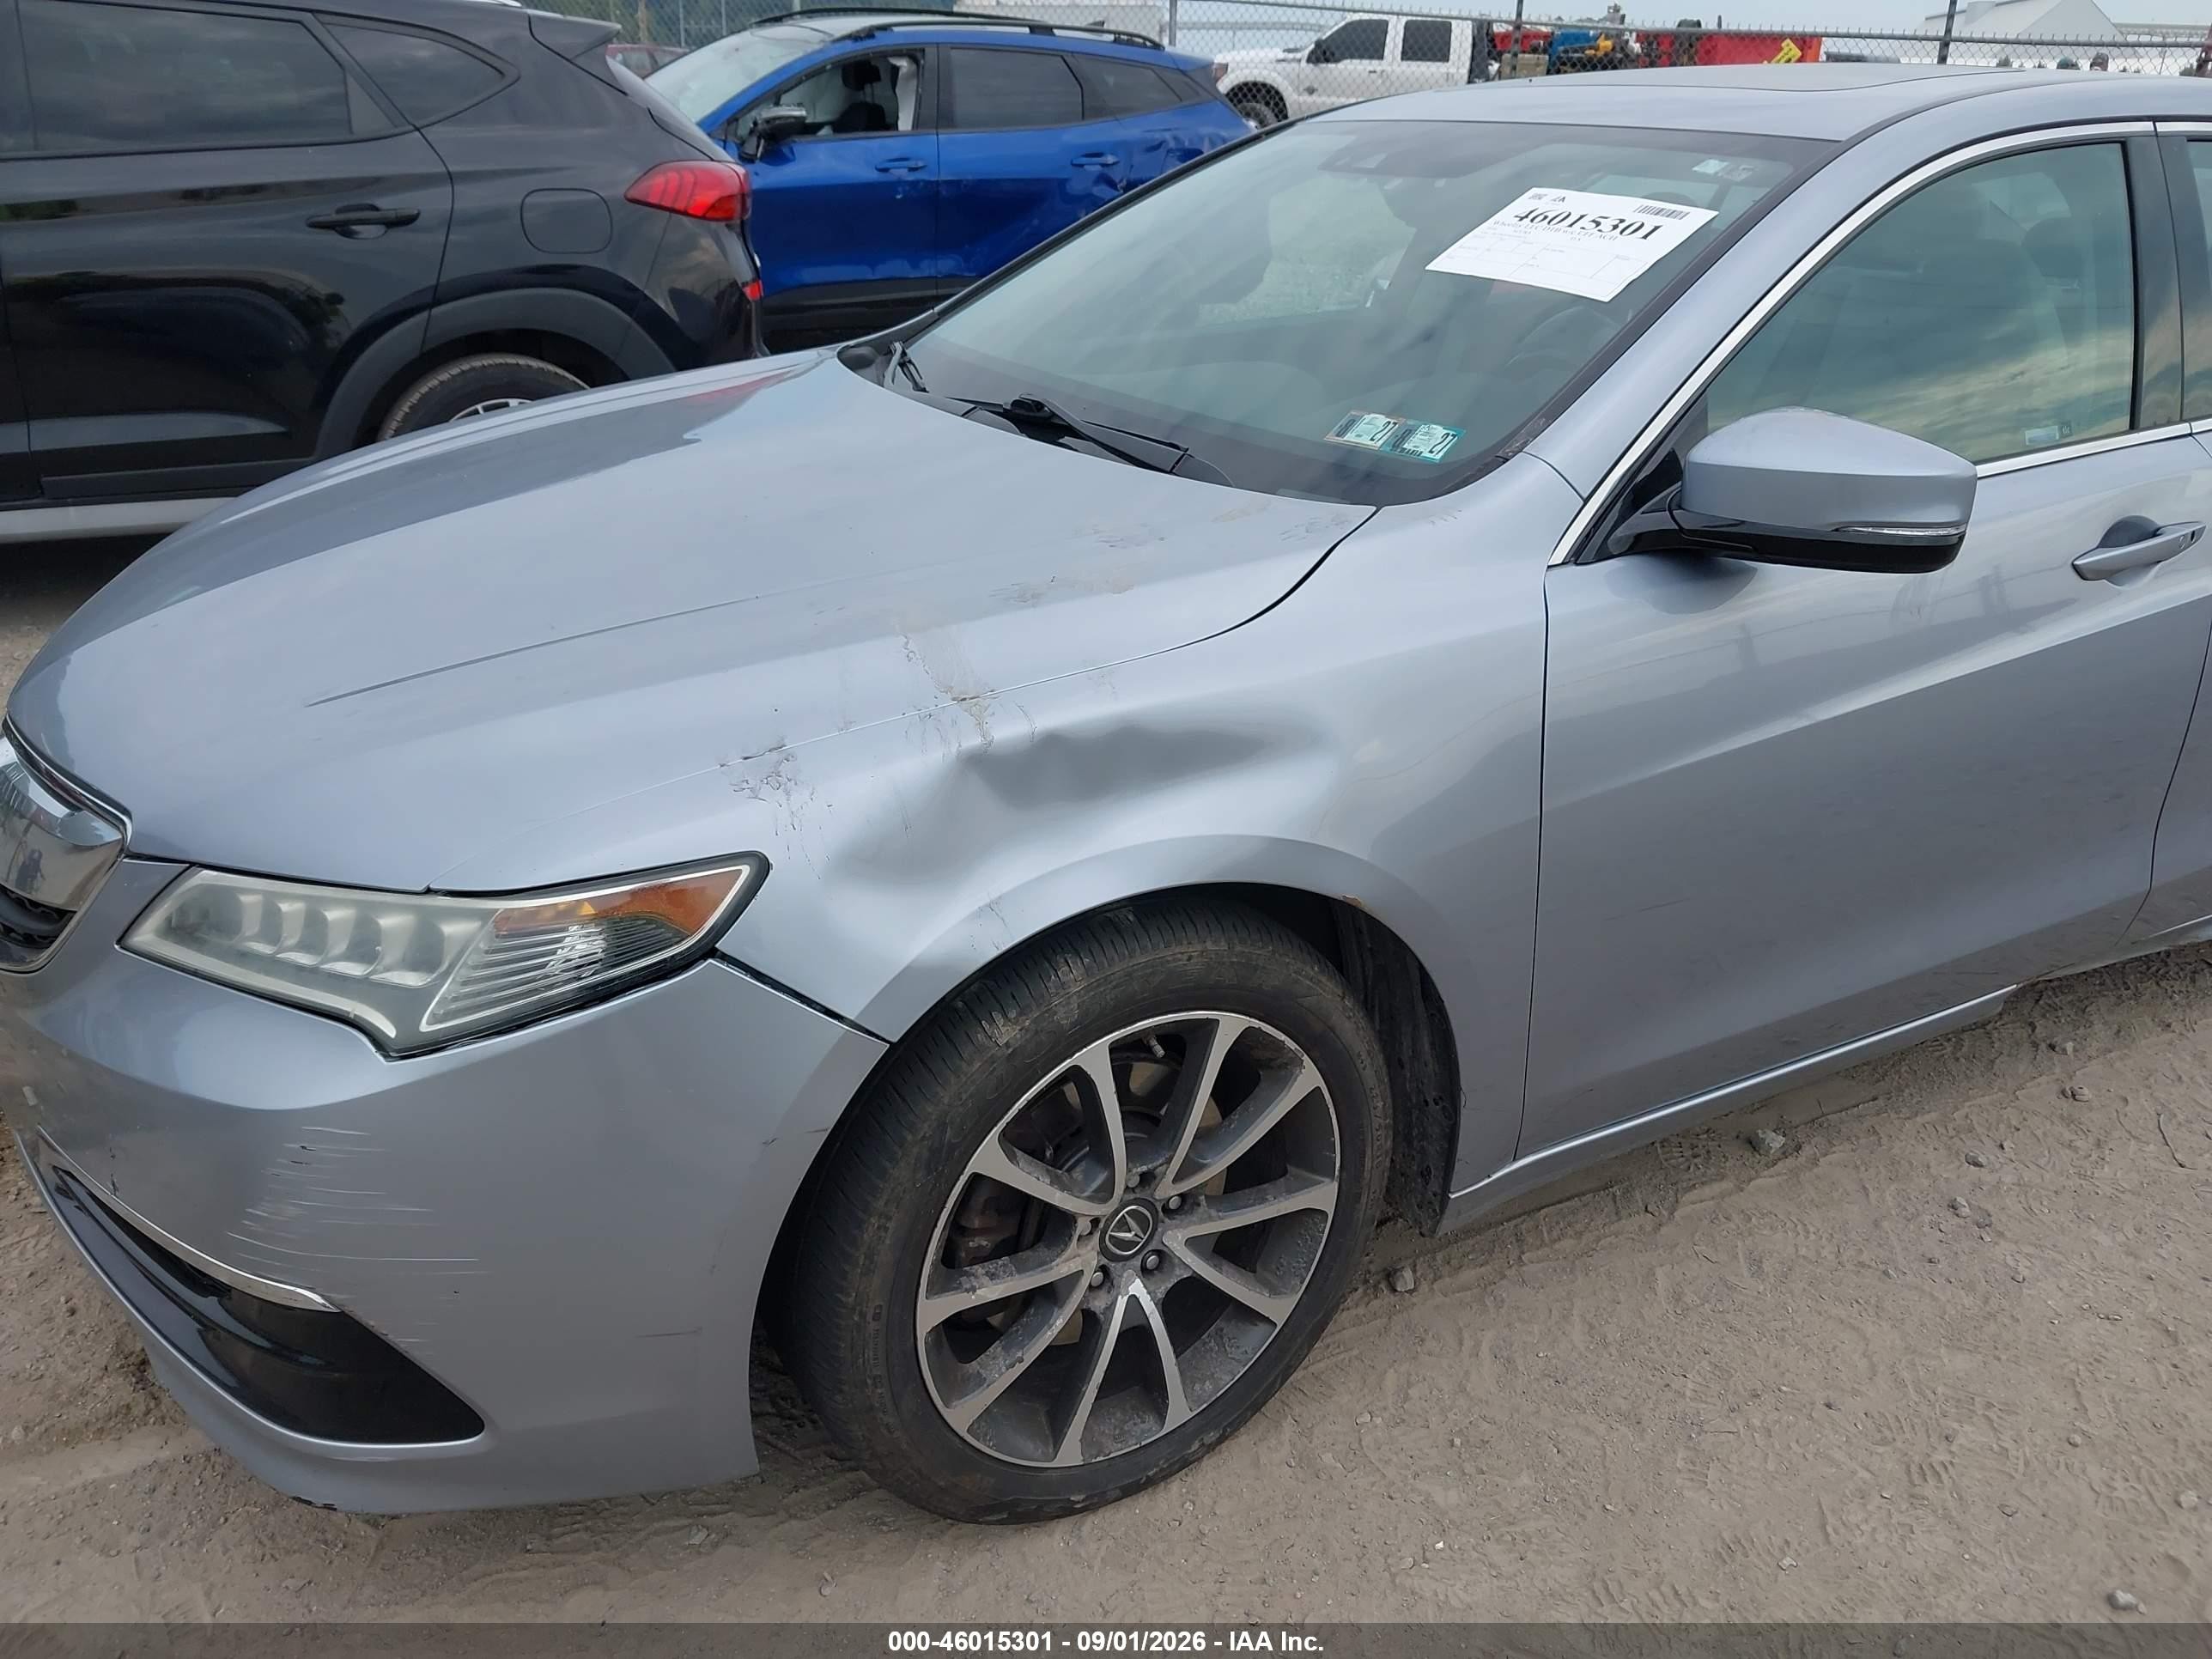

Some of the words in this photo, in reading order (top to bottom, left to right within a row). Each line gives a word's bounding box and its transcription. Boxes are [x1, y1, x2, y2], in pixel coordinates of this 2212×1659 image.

[1513, 207, 1664, 241] 46015301
[1370, 420, 1398, 442] 27
[1428, 432, 1457, 455] 27
